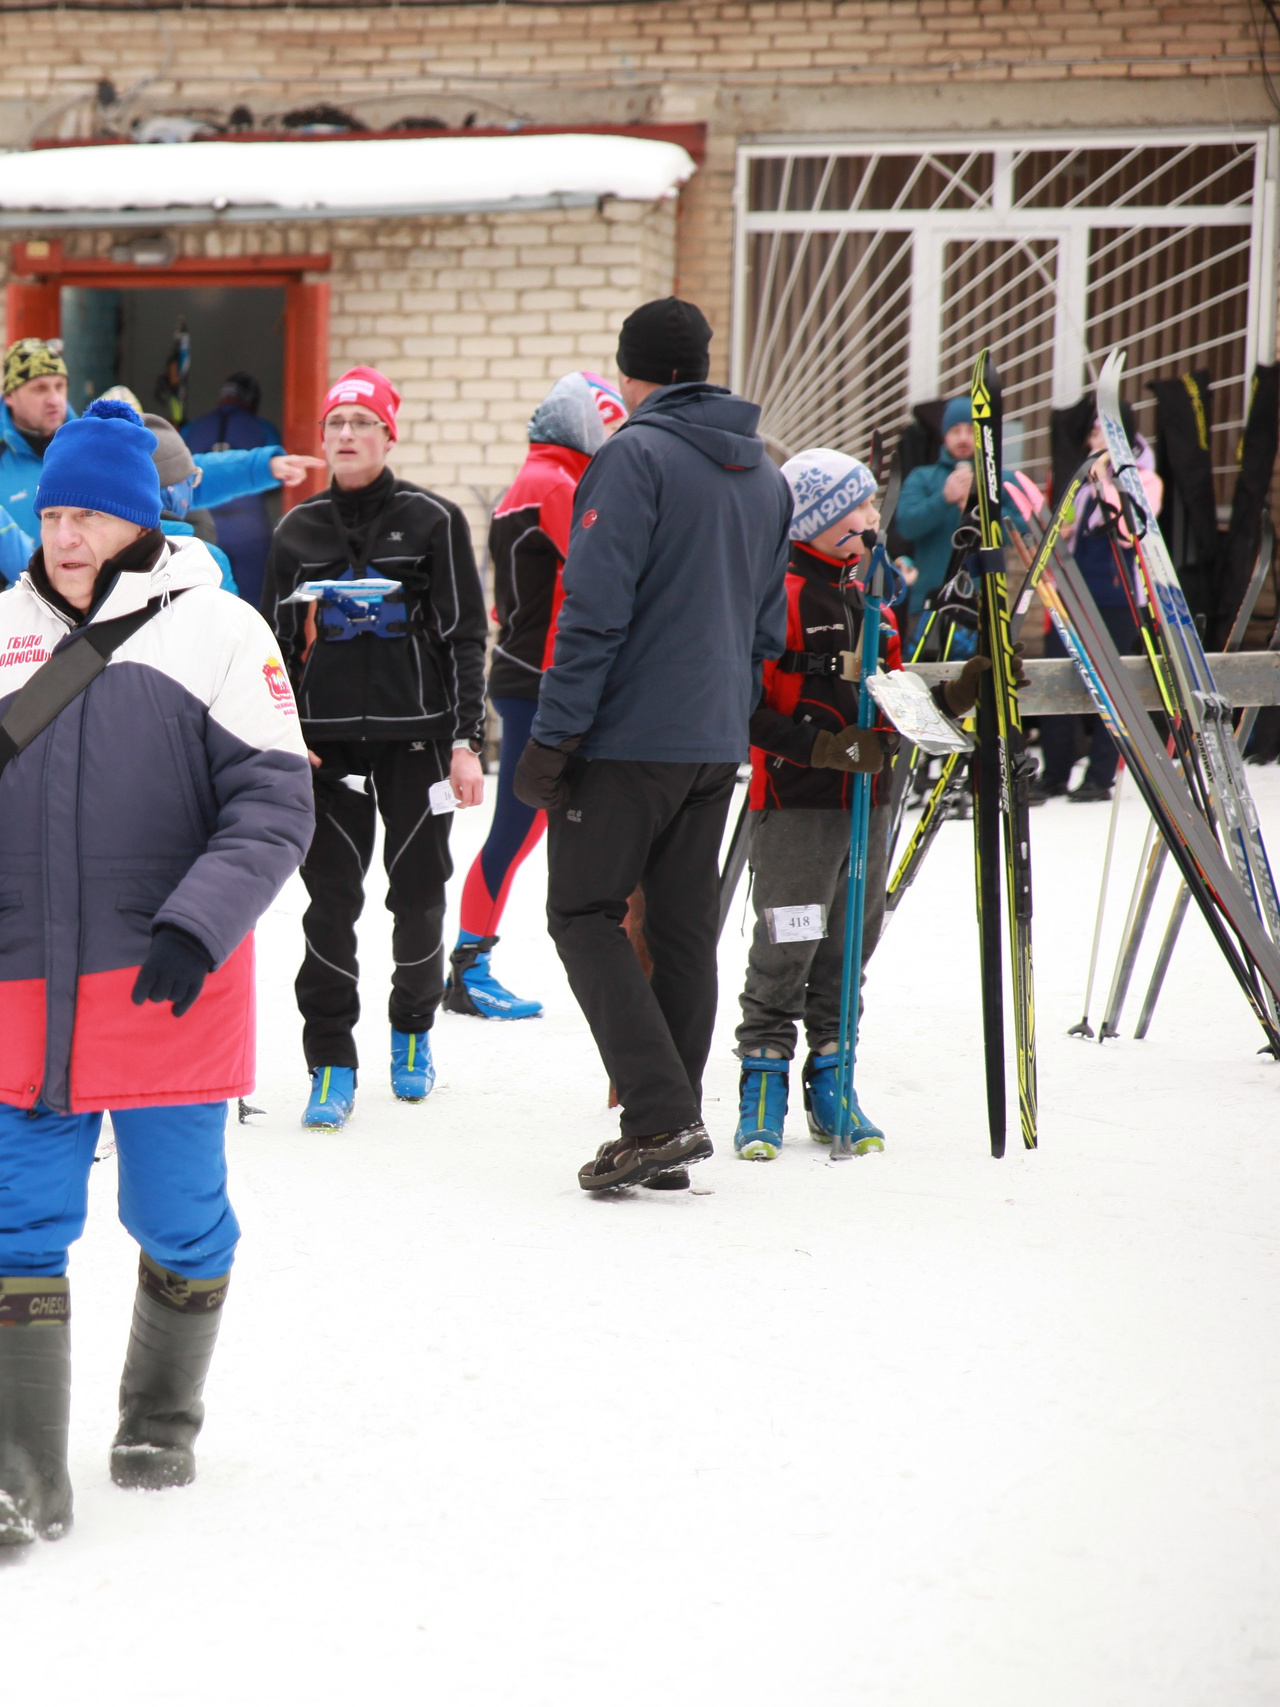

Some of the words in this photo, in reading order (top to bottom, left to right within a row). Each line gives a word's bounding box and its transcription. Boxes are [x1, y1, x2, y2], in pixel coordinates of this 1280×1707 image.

[983, 425, 999, 504] FISCHER
[1031, 479, 1081, 588] FISCHER
[7, 634, 43, 650] ГБУДО
[997, 735, 1011, 814] FISCHER
[1195, 731, 1215, 784] NORDWAY
[789, 915, 810, 928] 418
[468, 987, 512, 1008] SPINE
[29, 1296, 69, 1315] CHESL
